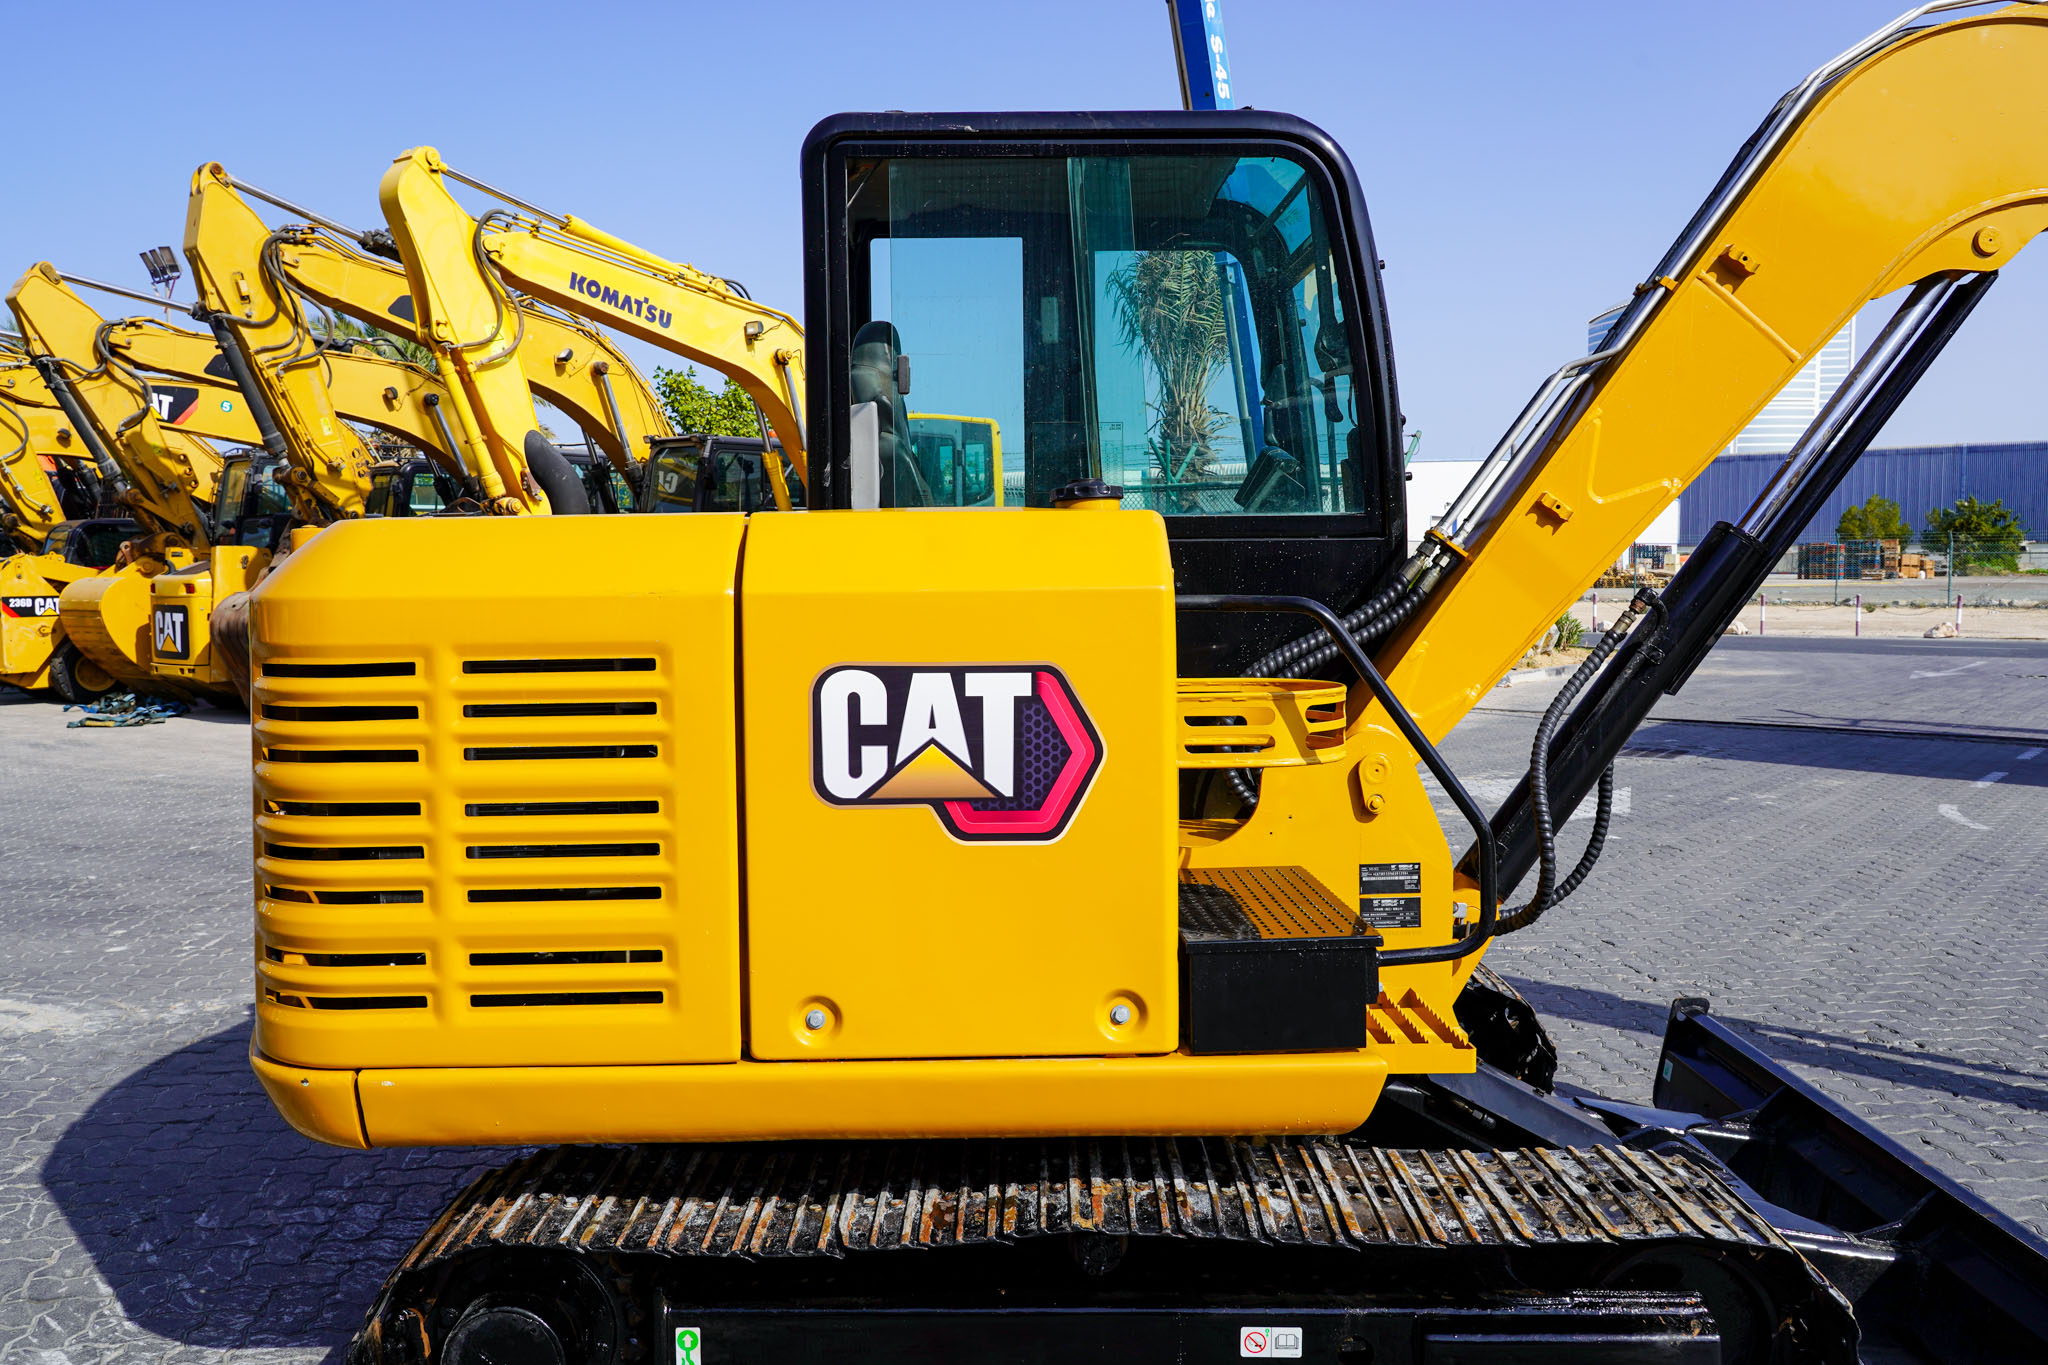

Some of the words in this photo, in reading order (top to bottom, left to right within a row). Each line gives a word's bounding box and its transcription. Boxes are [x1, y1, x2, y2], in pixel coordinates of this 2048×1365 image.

[1210, 33, 1230, 99] S-45
[569, 271, 672, 329] KOMATSU
[222, 401, 231, 412] 5
[9, 598, 32, 608] 236D
[155, 610, 184, 653] CAT
[820, 669, 1032, 799] CAT
